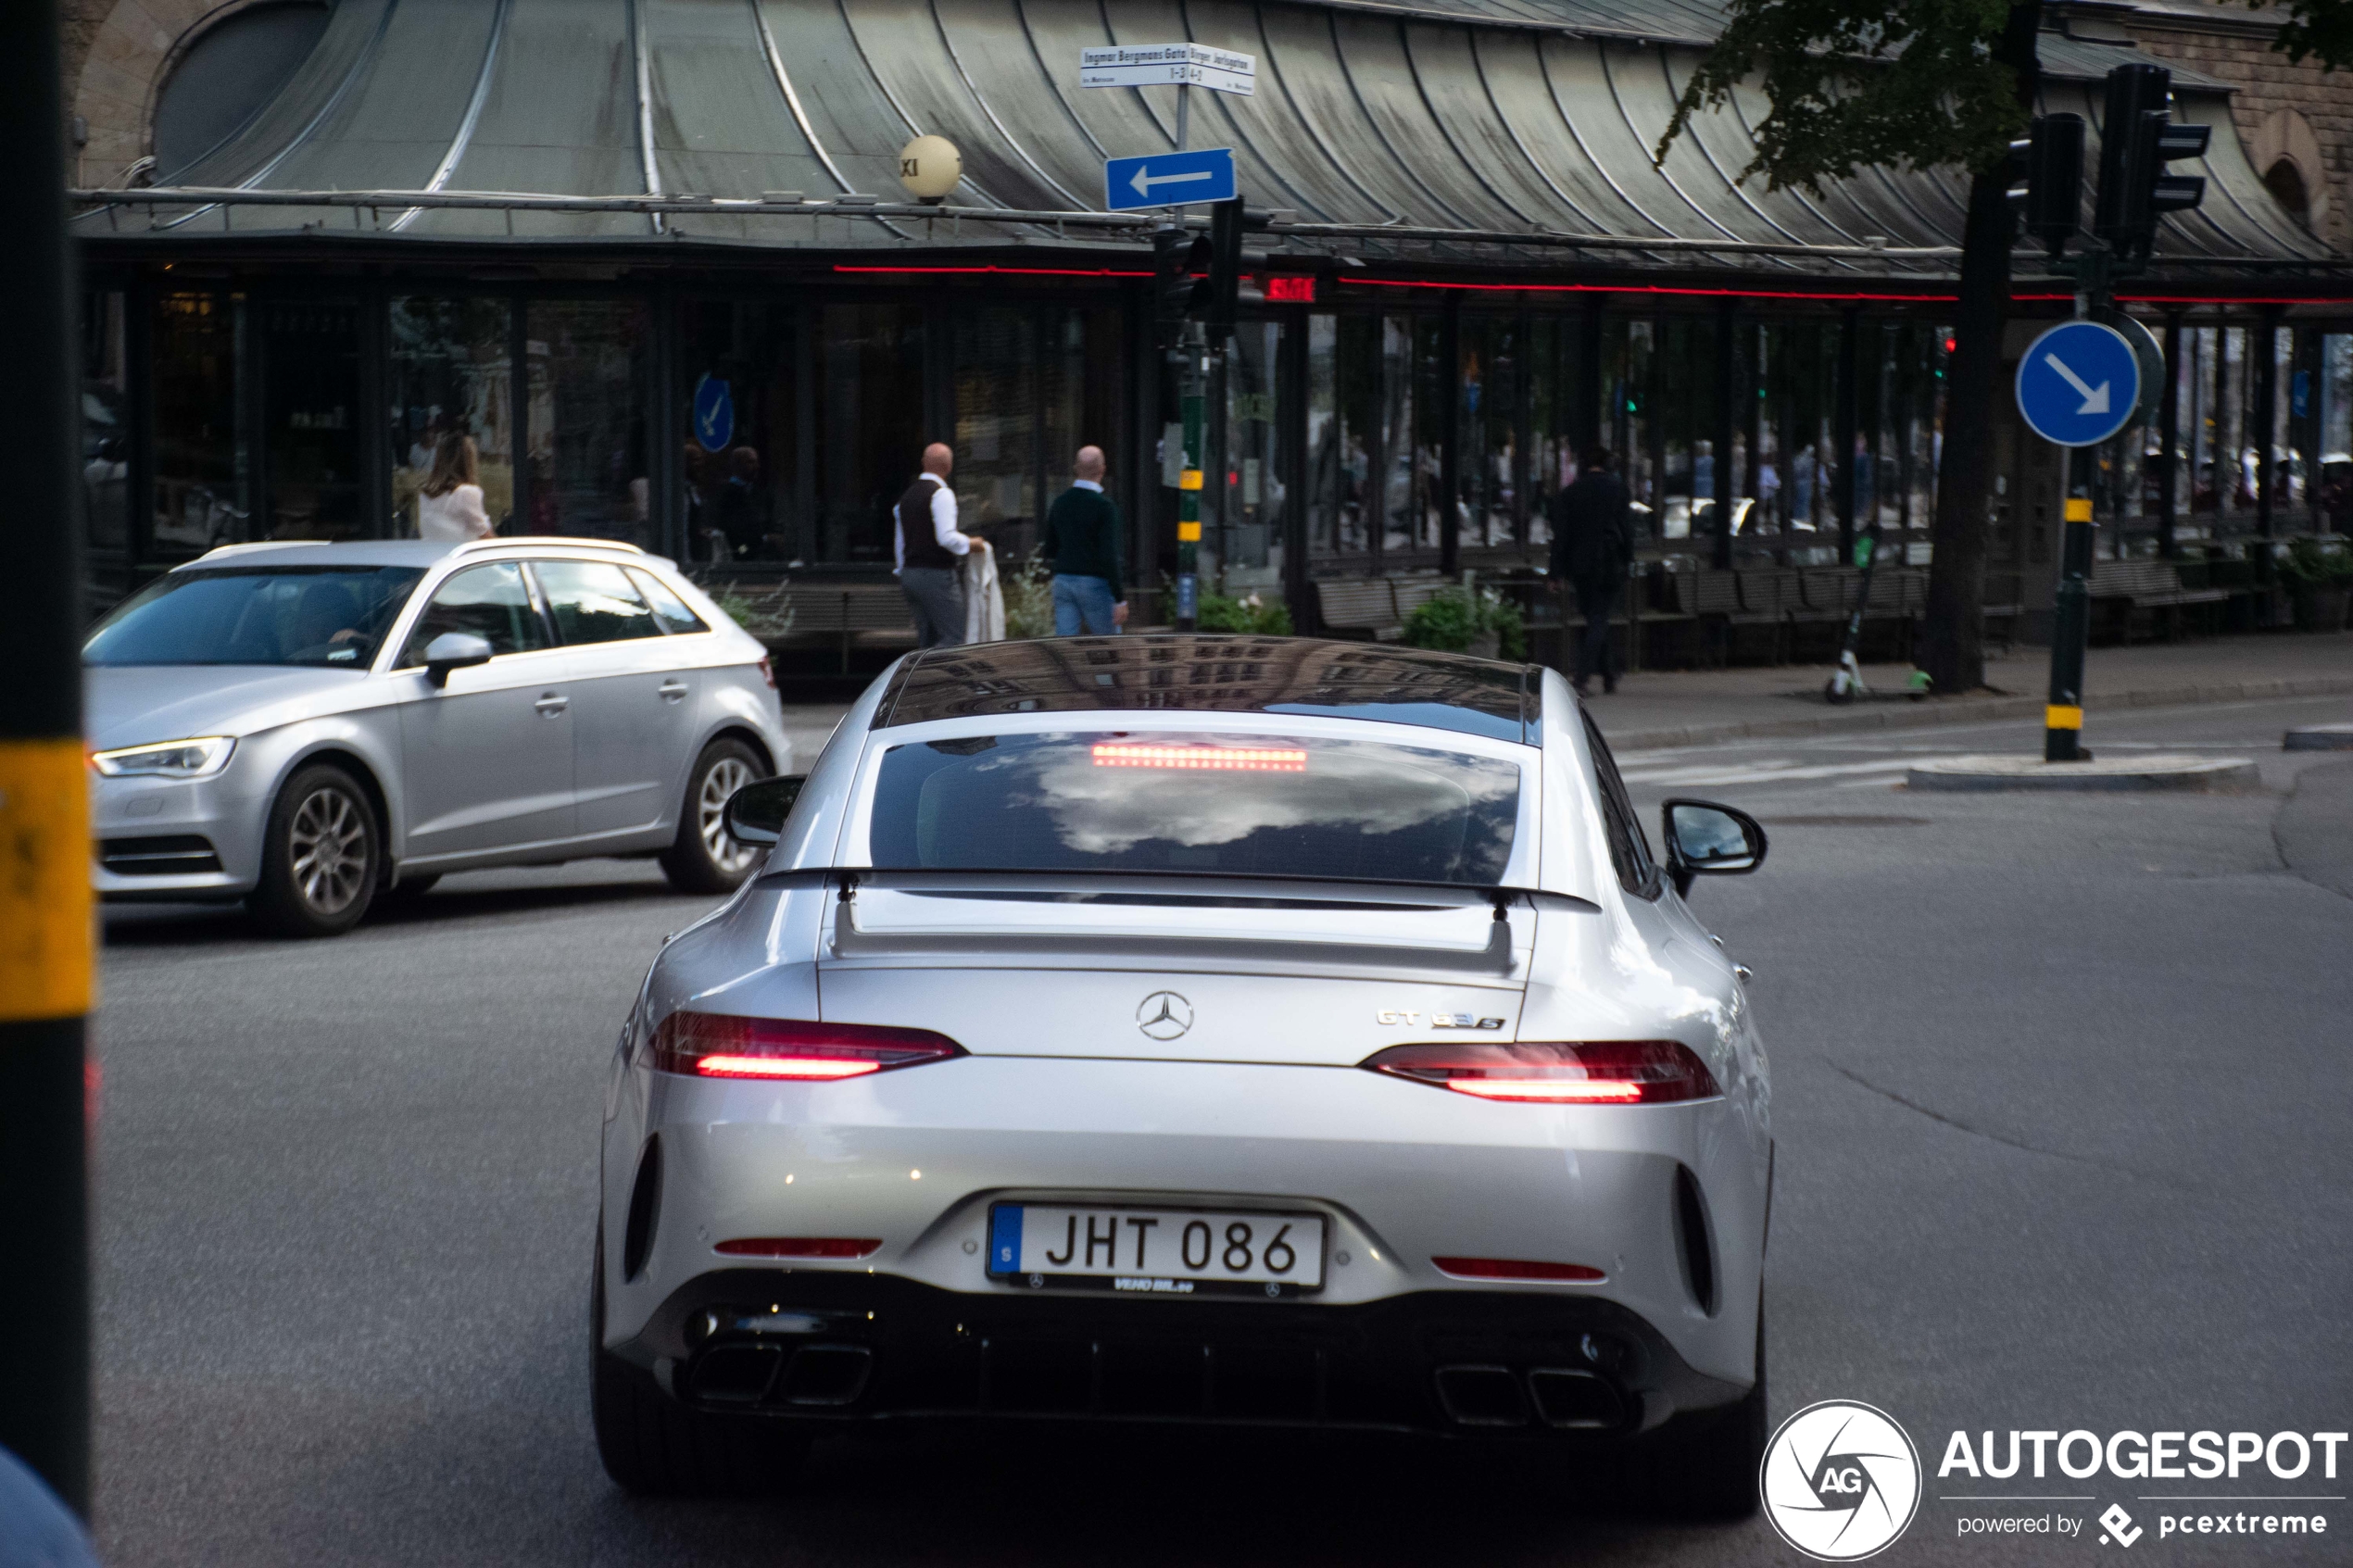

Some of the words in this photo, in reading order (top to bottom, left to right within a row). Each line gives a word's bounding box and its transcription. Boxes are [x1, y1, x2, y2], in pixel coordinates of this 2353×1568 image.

[1085, 52, 1116, 66] Ingmar
[1118, 50, 1163, 64] Bergmans
[1164, 47, 1186, 58] Gata
[1377, 1010, 1420, 1025] GT
[1045, 1215, 1158, 1270] JHT
[1181, 1220, 1297, 1275] 086
[1000, 1247, 1013, 1262] S
